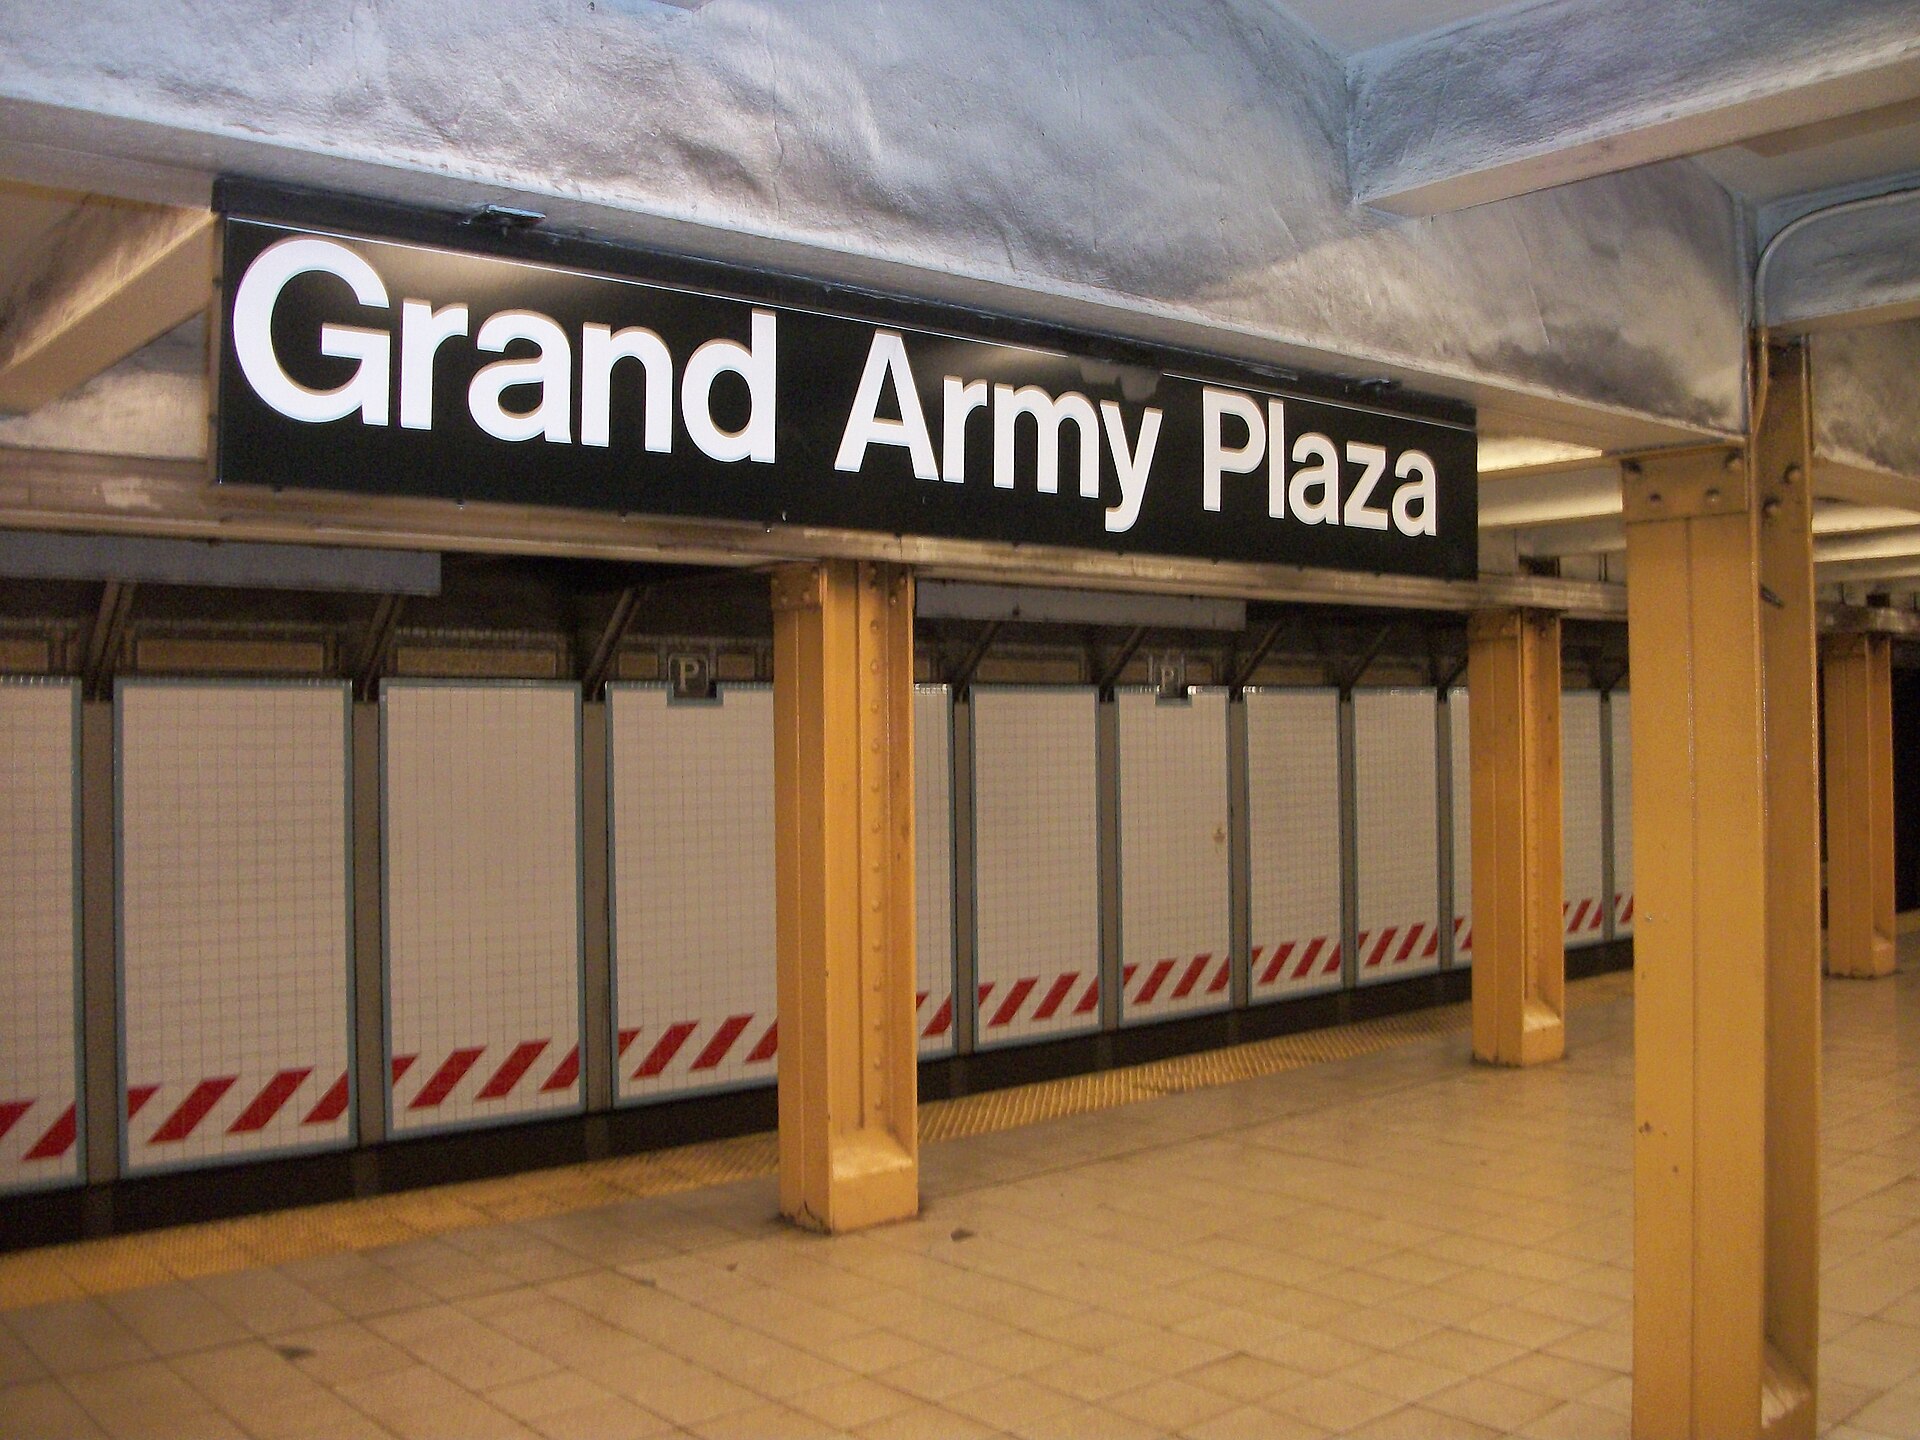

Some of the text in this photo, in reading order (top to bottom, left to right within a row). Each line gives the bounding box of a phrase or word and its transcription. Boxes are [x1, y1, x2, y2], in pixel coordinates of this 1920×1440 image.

[232, 237, 1438, 538] Grand Army Plaza
[679, 656, 700, 692] P
